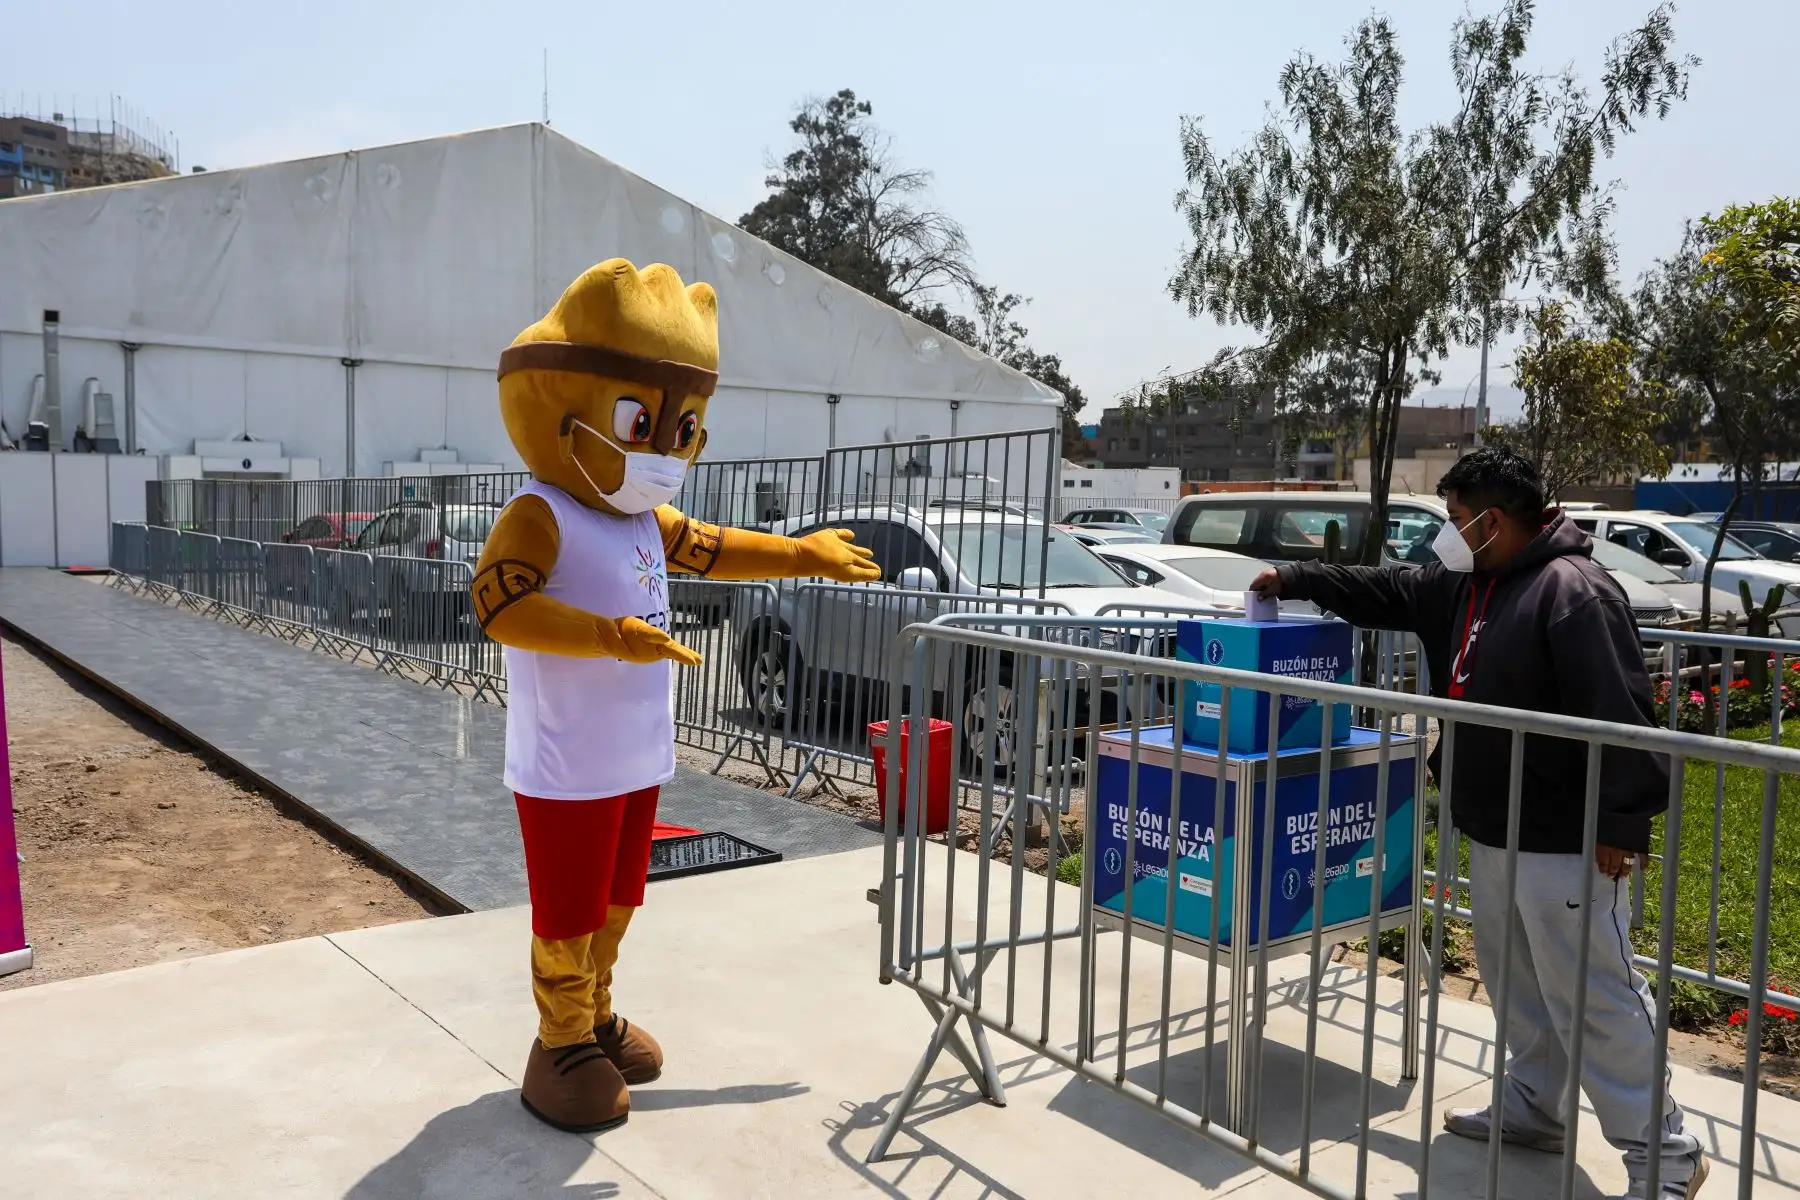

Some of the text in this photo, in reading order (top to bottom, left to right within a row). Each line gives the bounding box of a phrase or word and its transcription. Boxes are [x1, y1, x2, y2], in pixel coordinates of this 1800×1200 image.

[1273, 655, 1339, 672] BUZÓN DE LA
[1108, 803, 1162, 831] BUÓN
[1194, 823, 1215, 844] LA
[1286, 807, 1341, 835] BUZN
[1345, 802, 1364, 823] DE
